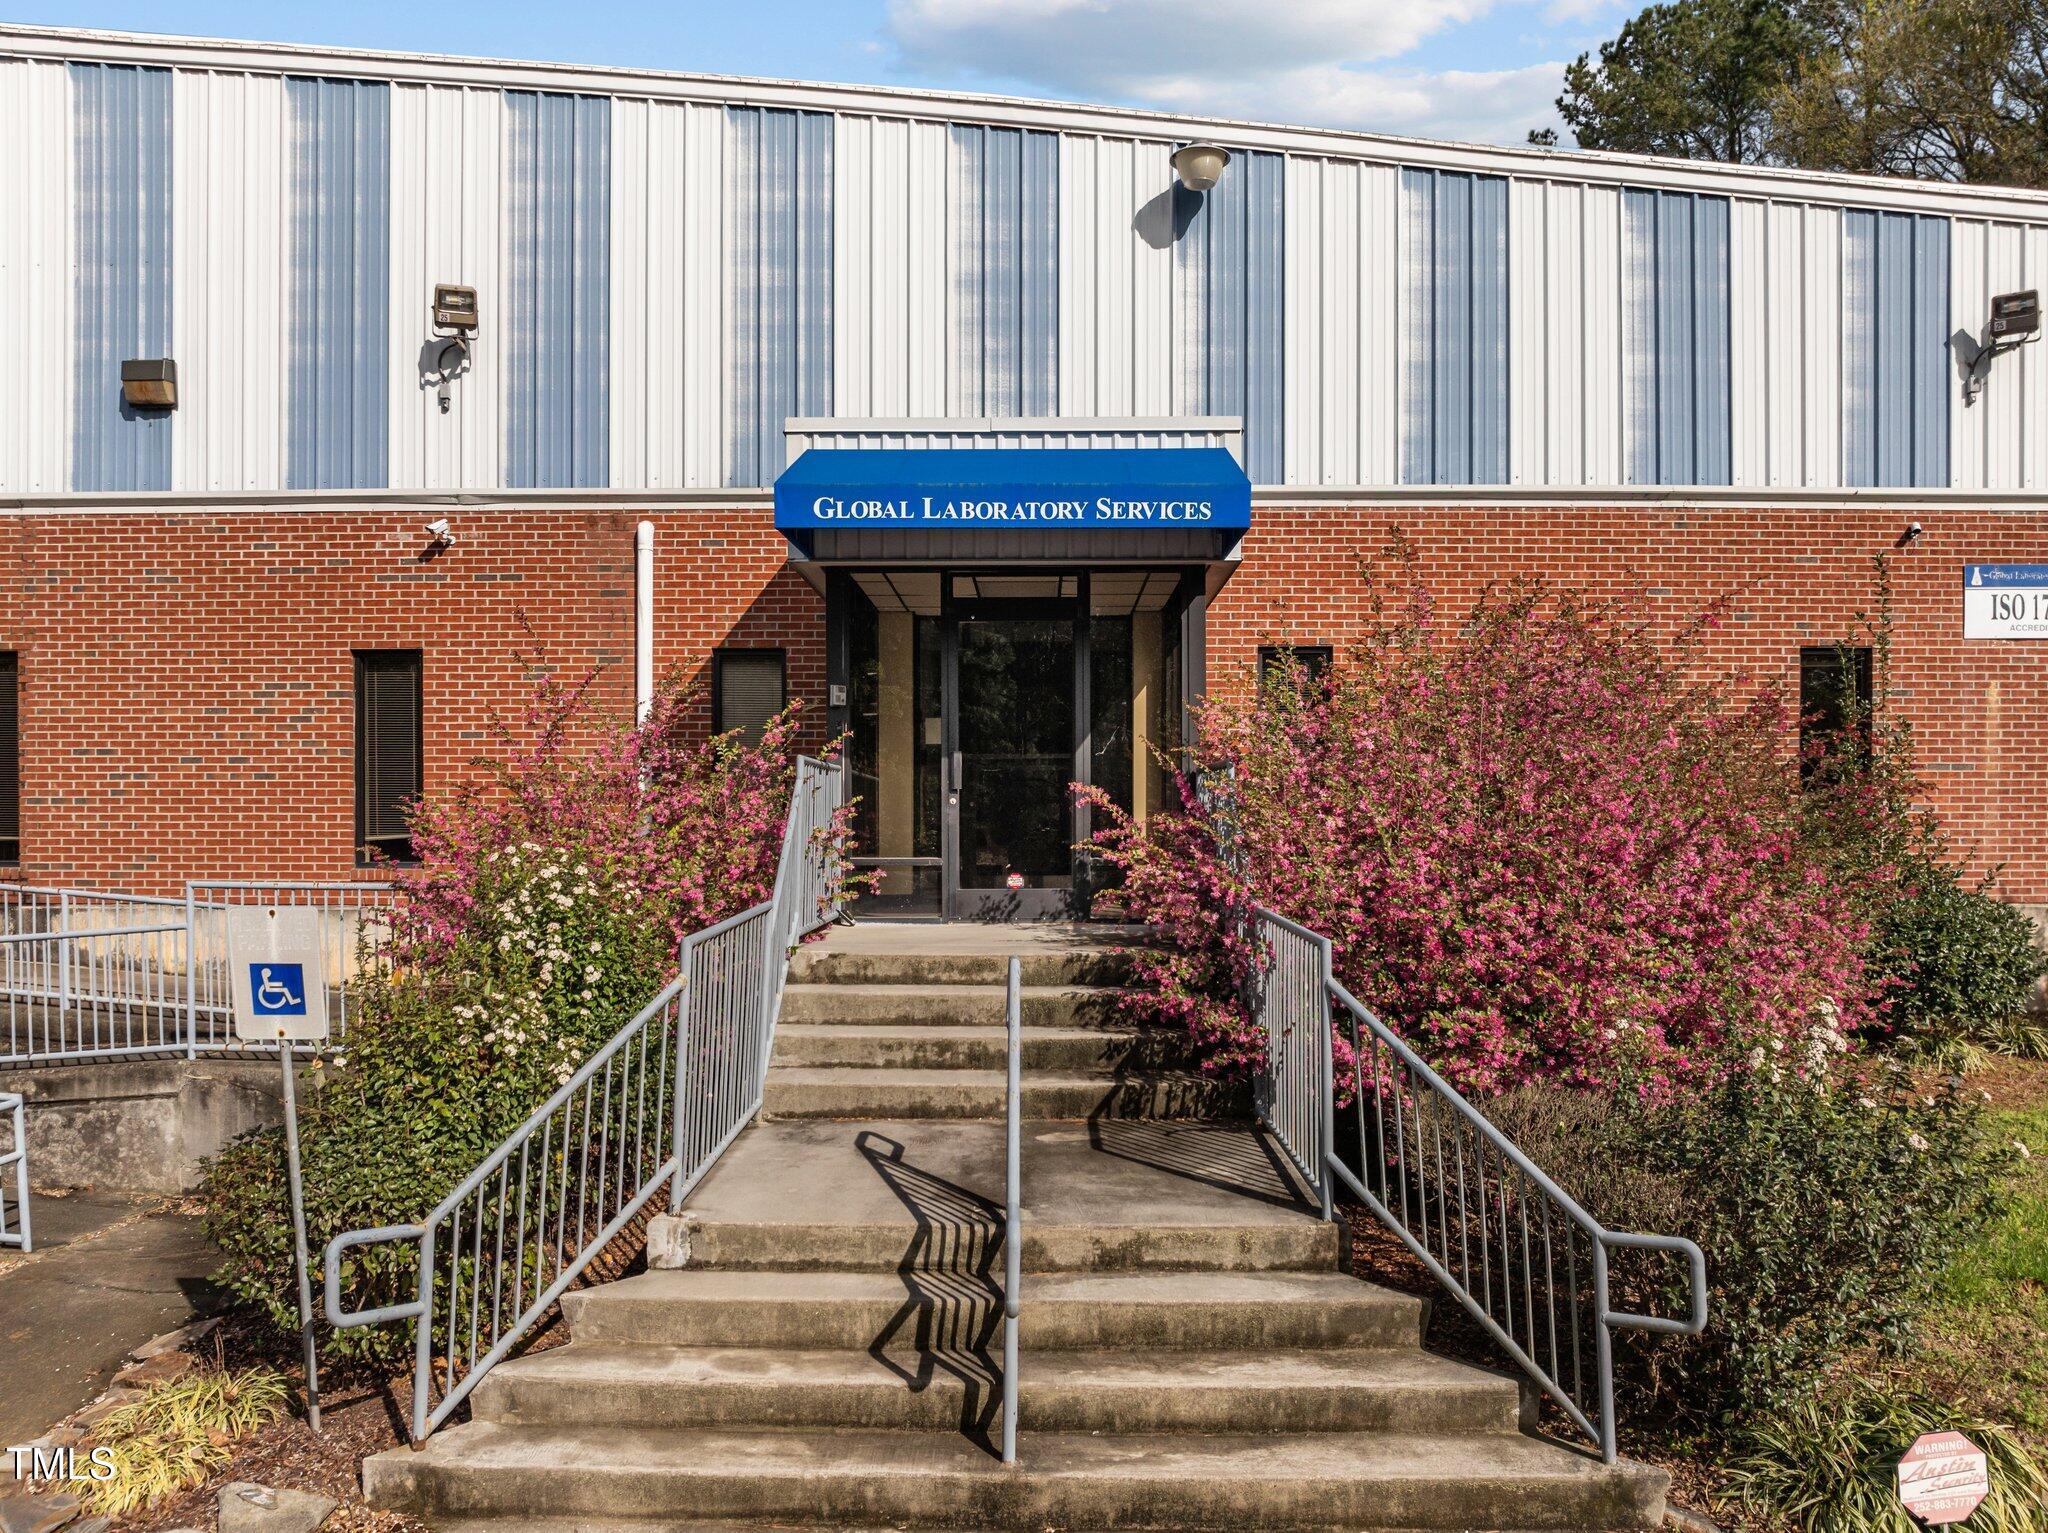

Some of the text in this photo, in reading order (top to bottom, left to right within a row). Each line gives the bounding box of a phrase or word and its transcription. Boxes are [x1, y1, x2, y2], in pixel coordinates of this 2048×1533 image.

[813, 496, 1212, 521] GLOBAL LABORATORY SERVICES
[1989, 570, 2013, 580] Global
[1991, 593, 2025, 620] ISO
[2010, 624, 2048, 632] ACCREDI
[1914, 1440, 1967, 1455] WARNING!
[1901, 1457, 1976, 1485] Austin
[1926, 1471, 1987, 1490] Security
